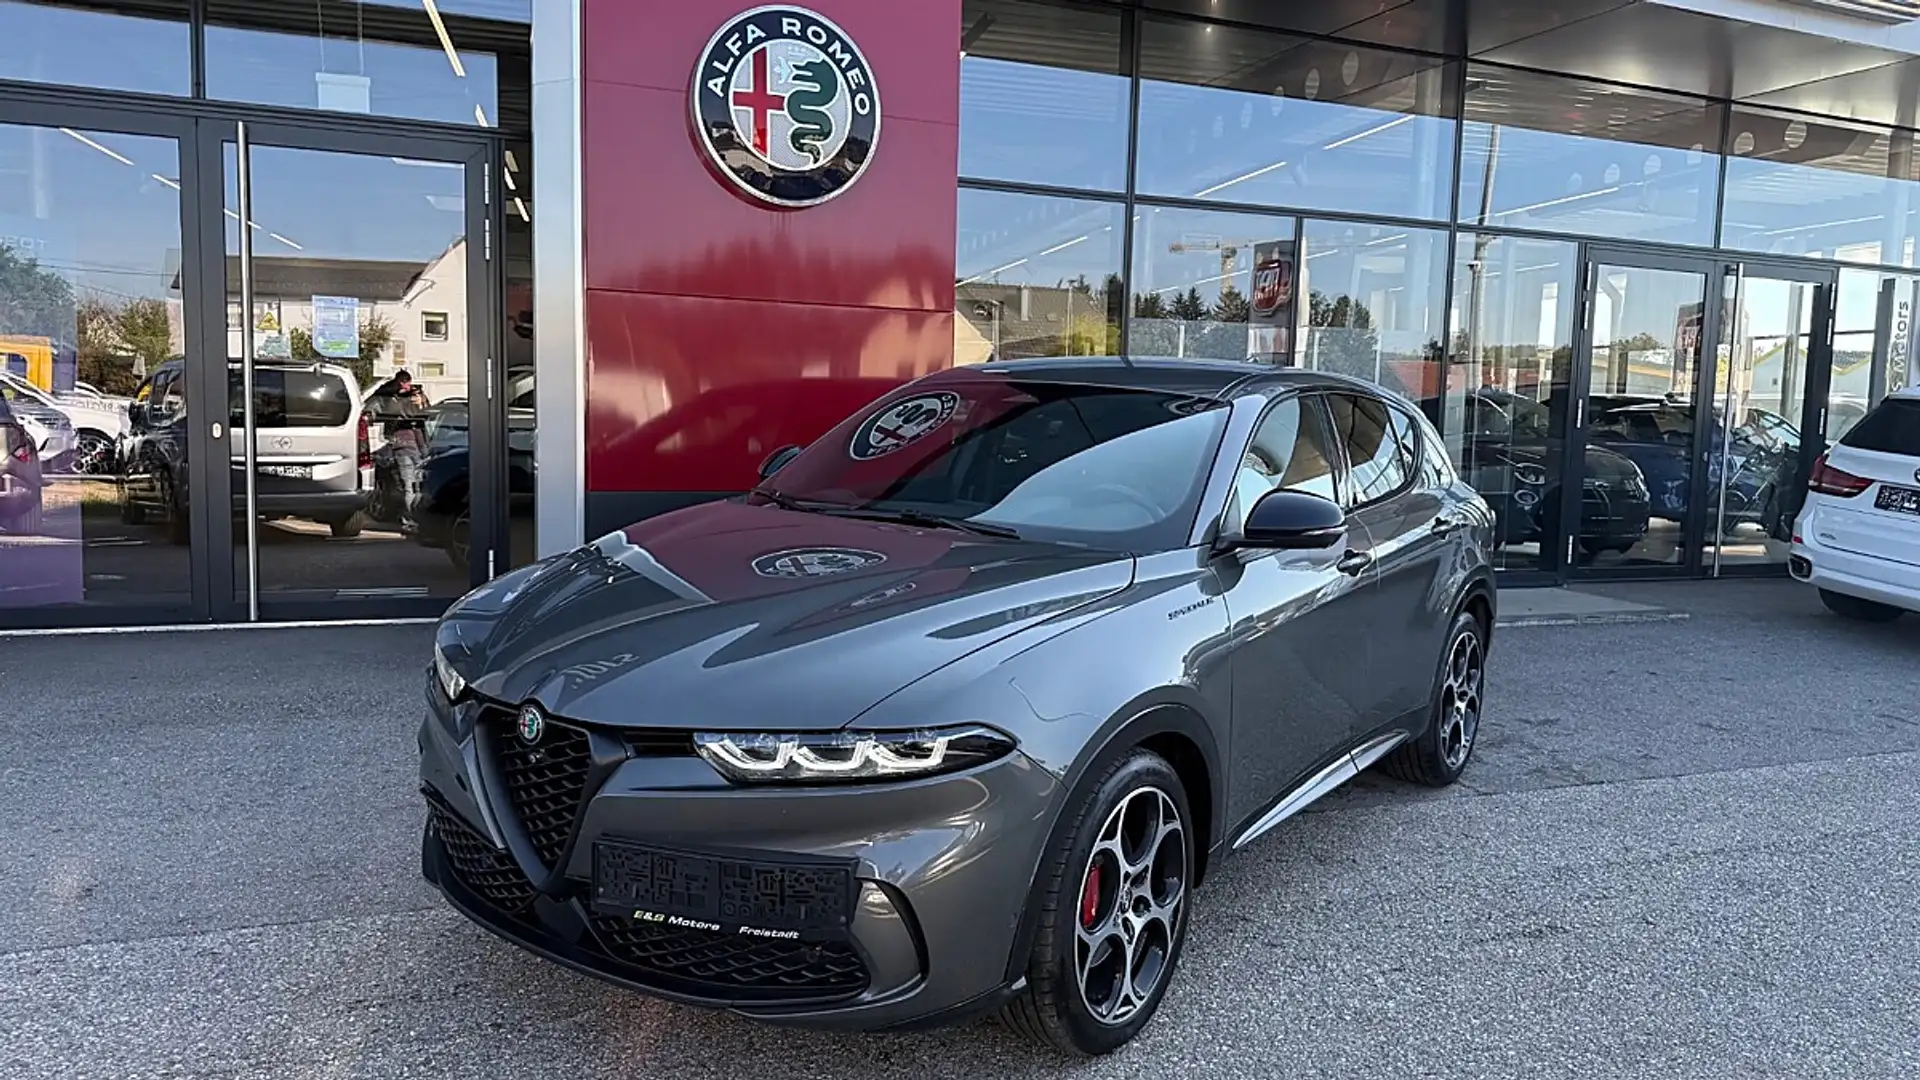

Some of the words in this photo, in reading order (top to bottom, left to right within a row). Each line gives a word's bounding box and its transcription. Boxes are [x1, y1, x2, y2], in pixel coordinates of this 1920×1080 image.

[707, 23, 766, 97] ALFA
[781, 17, 870, 115] ROMEO
[667, 915, 720, 931] Motors
[738, 926, 800, 940] Freistadt
